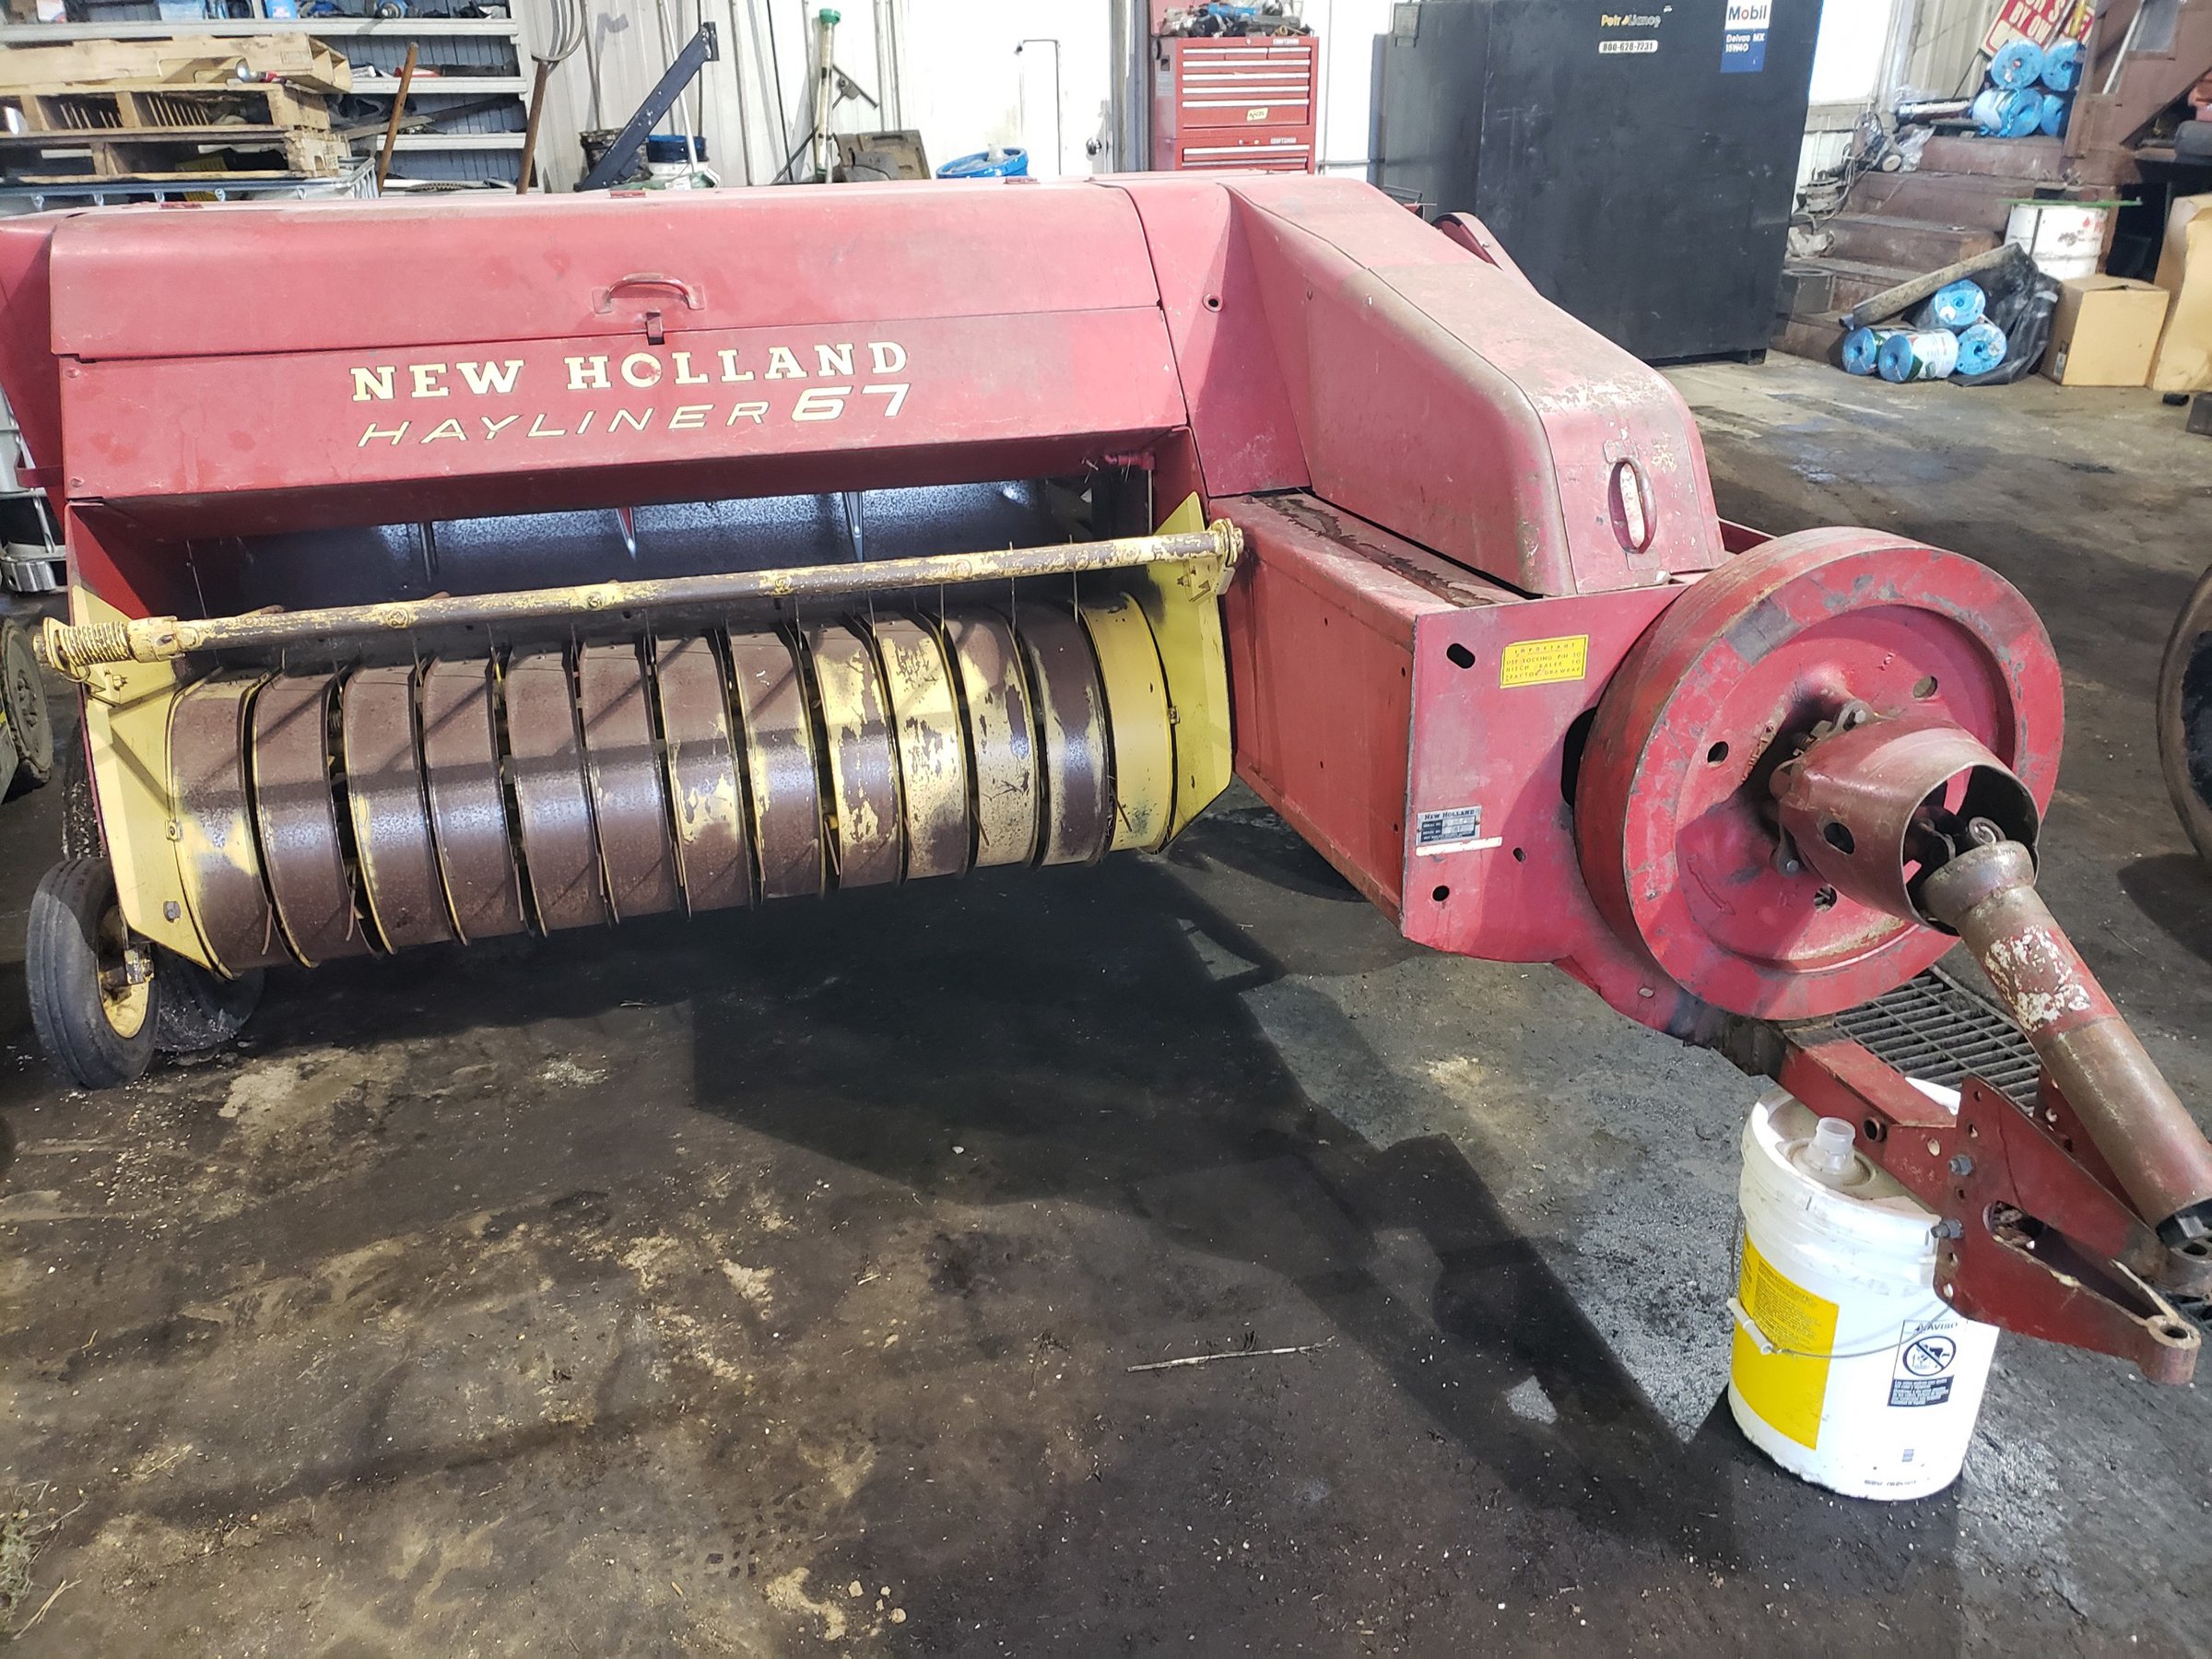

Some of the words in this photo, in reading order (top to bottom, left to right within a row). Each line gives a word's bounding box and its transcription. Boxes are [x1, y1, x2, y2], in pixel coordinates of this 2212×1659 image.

[1727, 5, 1767, 20] Mobil
[1725, 34, 1750, 42] Delvac
[1753, 32, 1765, 41] MX
[349, 359, 525, 402] NEW
[563, 341, 908, 390] HOLLAND
[357, 400, 771, 448] HAYLINER
[791, 383, 911, 422] 67
[1514, 643, 1575, 653] IMPORTANT
[1523, 655, 1553, 664] LOCKING
[1442, 809, 1476, 818] HOLLAND
